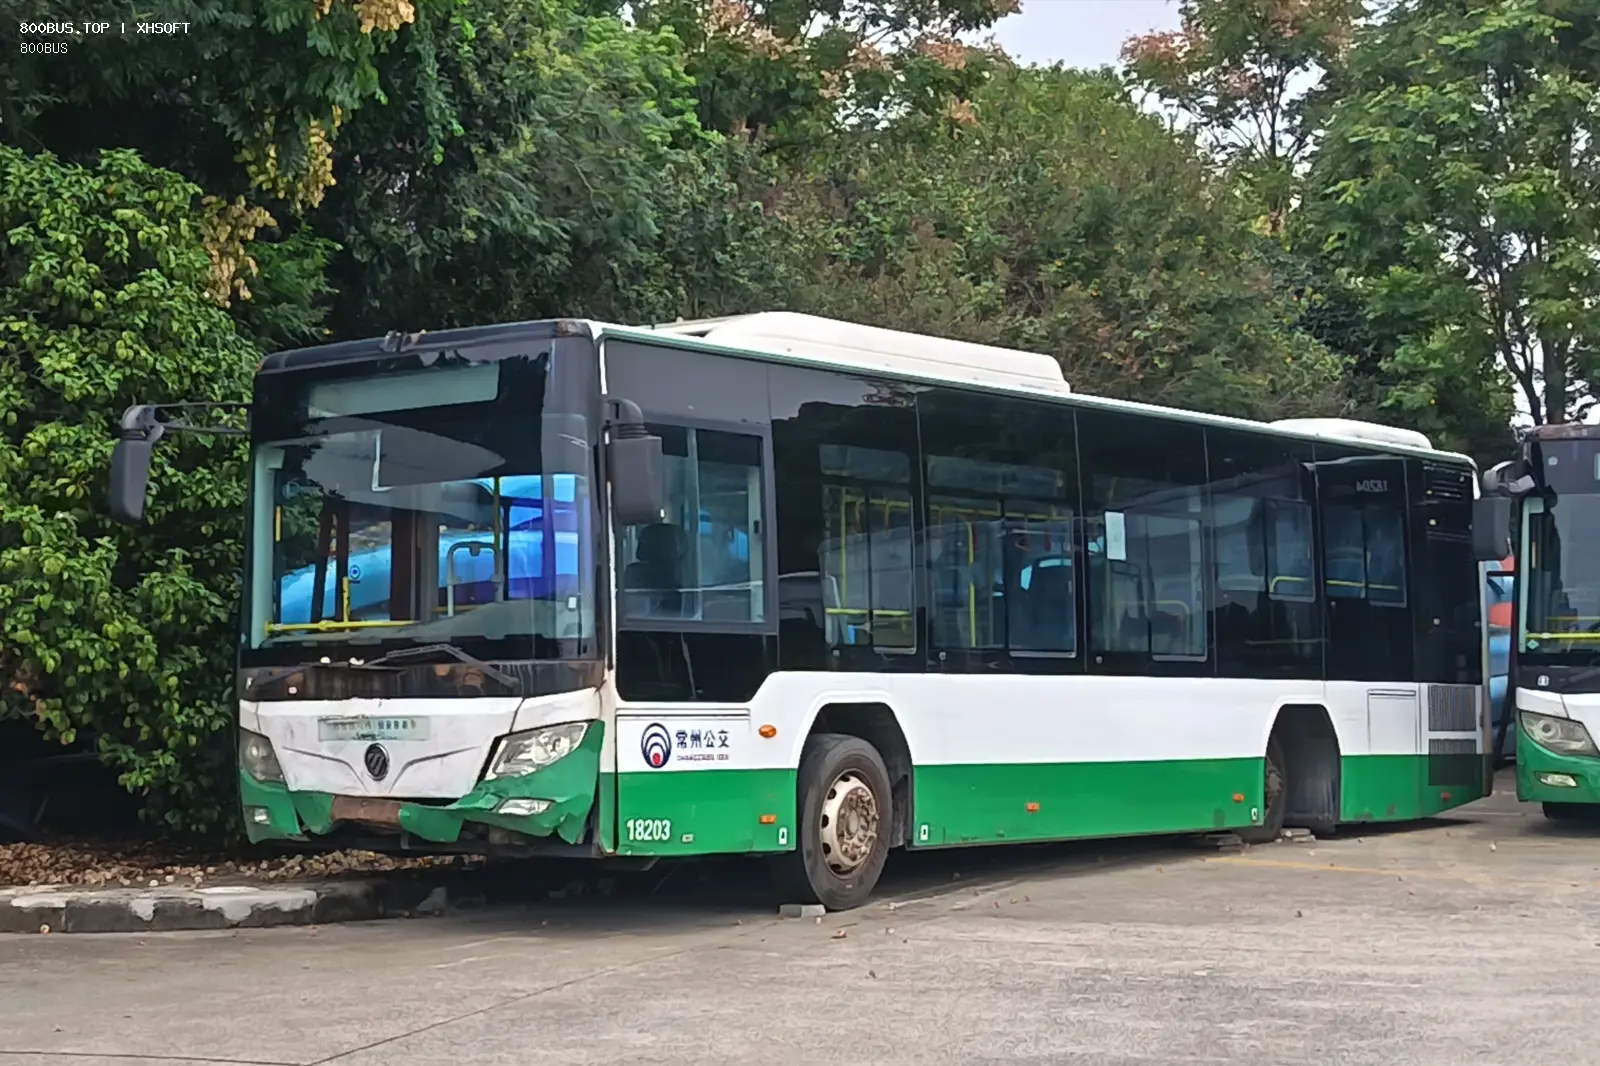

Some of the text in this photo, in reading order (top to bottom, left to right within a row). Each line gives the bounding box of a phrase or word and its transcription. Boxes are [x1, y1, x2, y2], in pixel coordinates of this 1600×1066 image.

[675, 729, 730, 748] 常州公交
[626, 819, 672, 841] 18203
